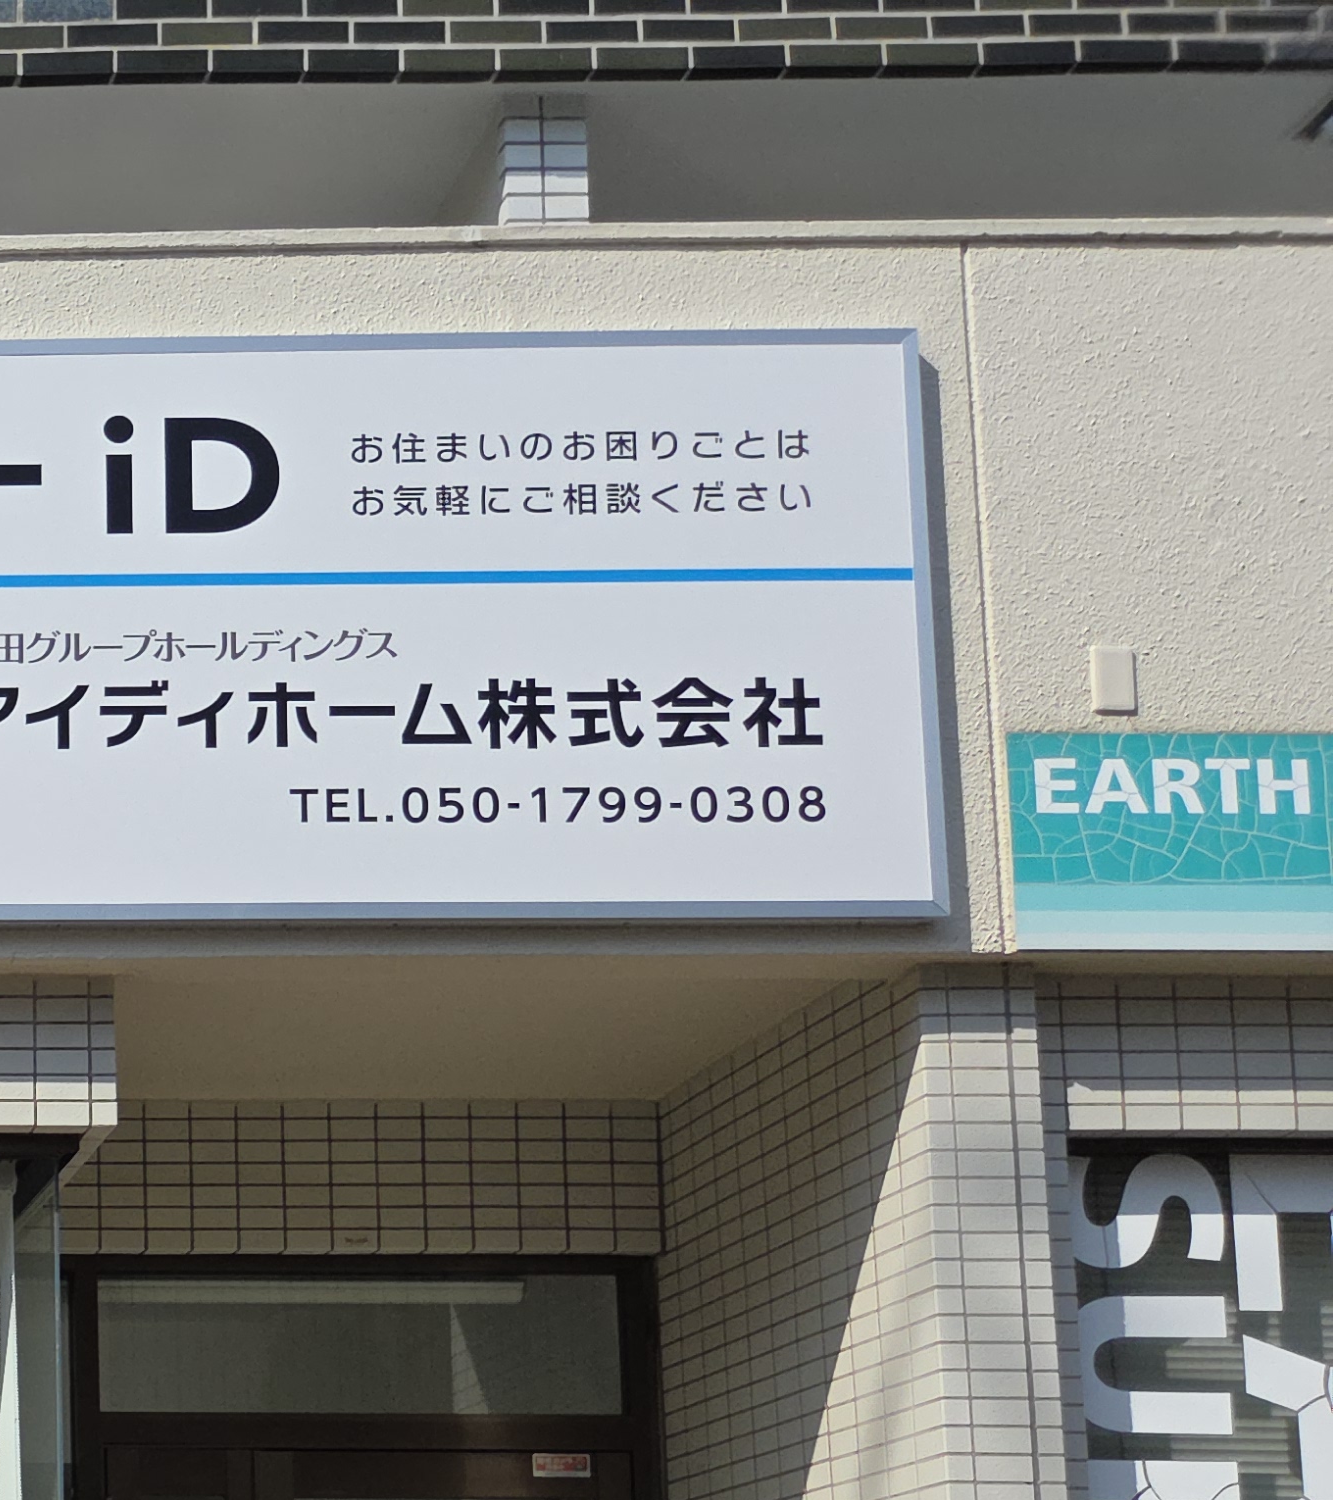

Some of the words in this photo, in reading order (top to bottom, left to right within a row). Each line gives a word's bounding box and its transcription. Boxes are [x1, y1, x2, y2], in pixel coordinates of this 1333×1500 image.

[350, 428, 812, 464] お住まいのお困りごとは
[102, 415, 280, 535] iD
[350, 480, 813, 517] お気軽にご相談ください
[288, 786, 828, 824] TEL.050-1799-0308
[1033, 757, 1311, 815] EARTH
